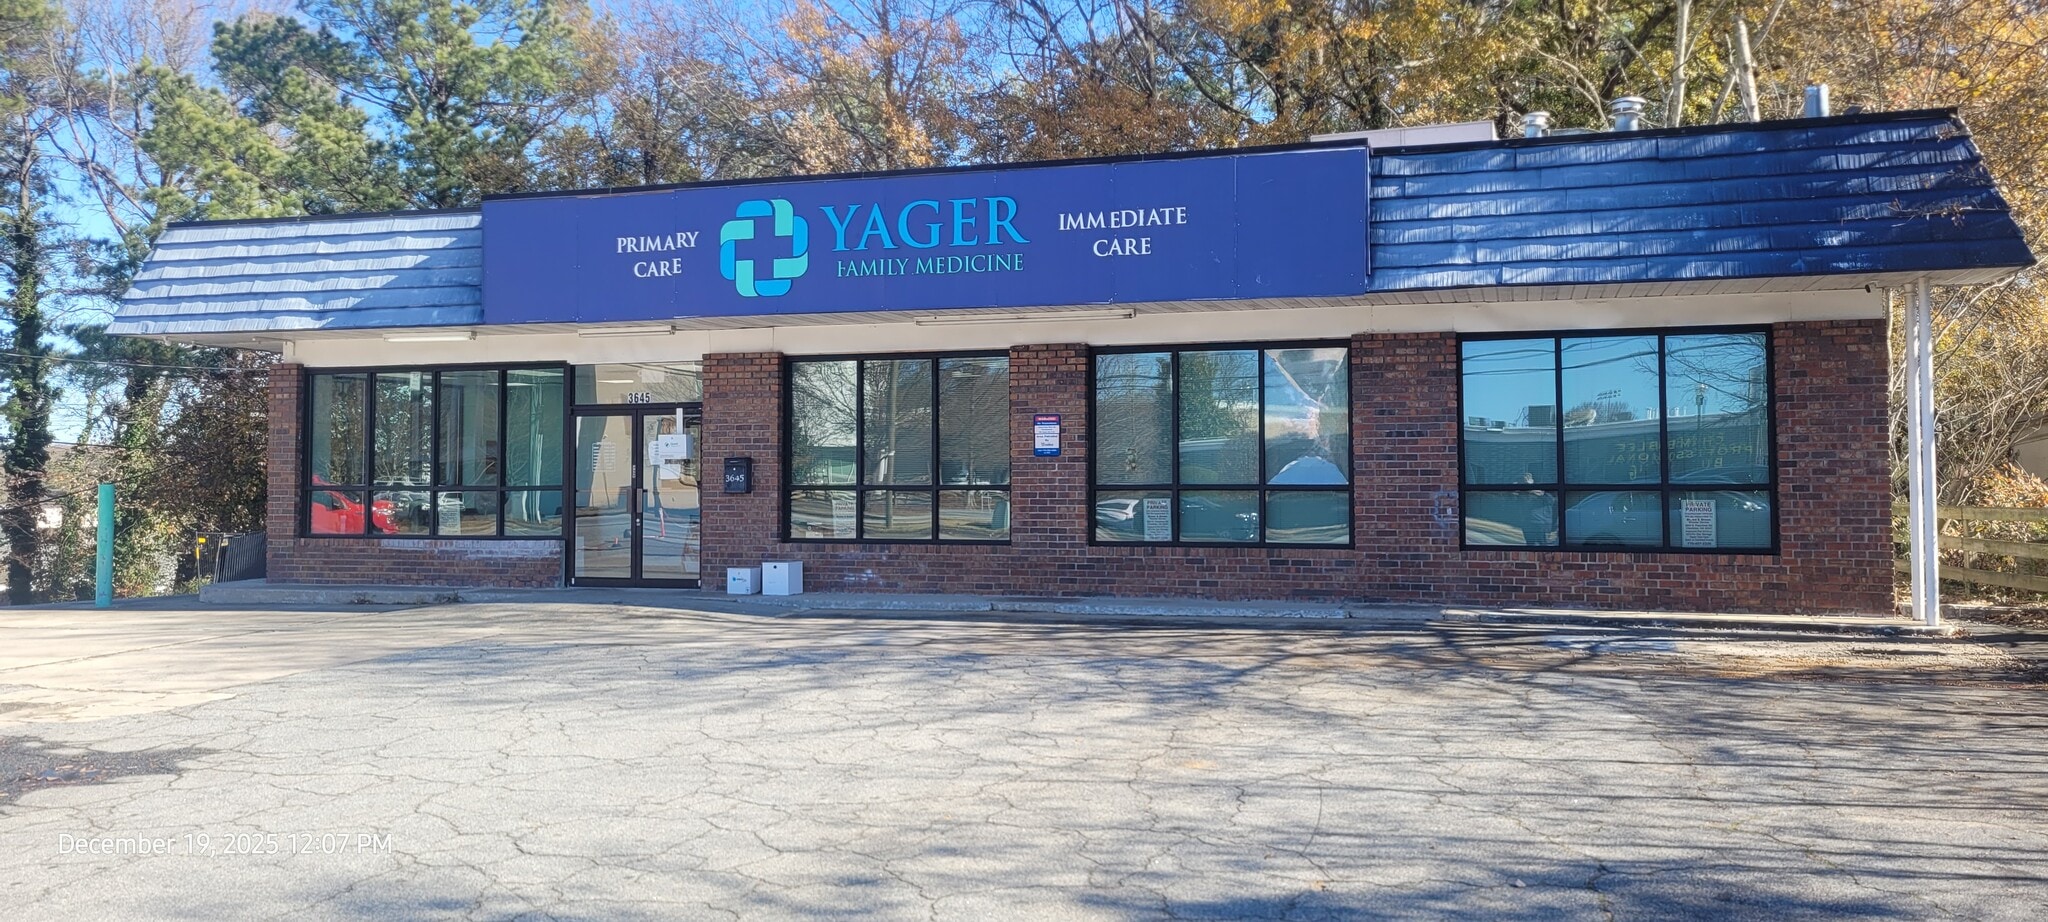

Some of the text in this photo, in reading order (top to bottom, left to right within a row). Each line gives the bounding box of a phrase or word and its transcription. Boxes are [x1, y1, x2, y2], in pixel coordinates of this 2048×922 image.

[819, 196, 1030, 251] YAGER
[1059, 206, 1187, 230] IMMEDIATE
[616, 231, 699, 253] PRIMARY
[1093, 237, 1151, 256] CARE
[634, 258, 681, 277] CARE
[837, 253, 1024, 277] FAMILY MEDICINE
[628, 392, 651, 404] 3645
[725, 474, 745, 483] 3645
